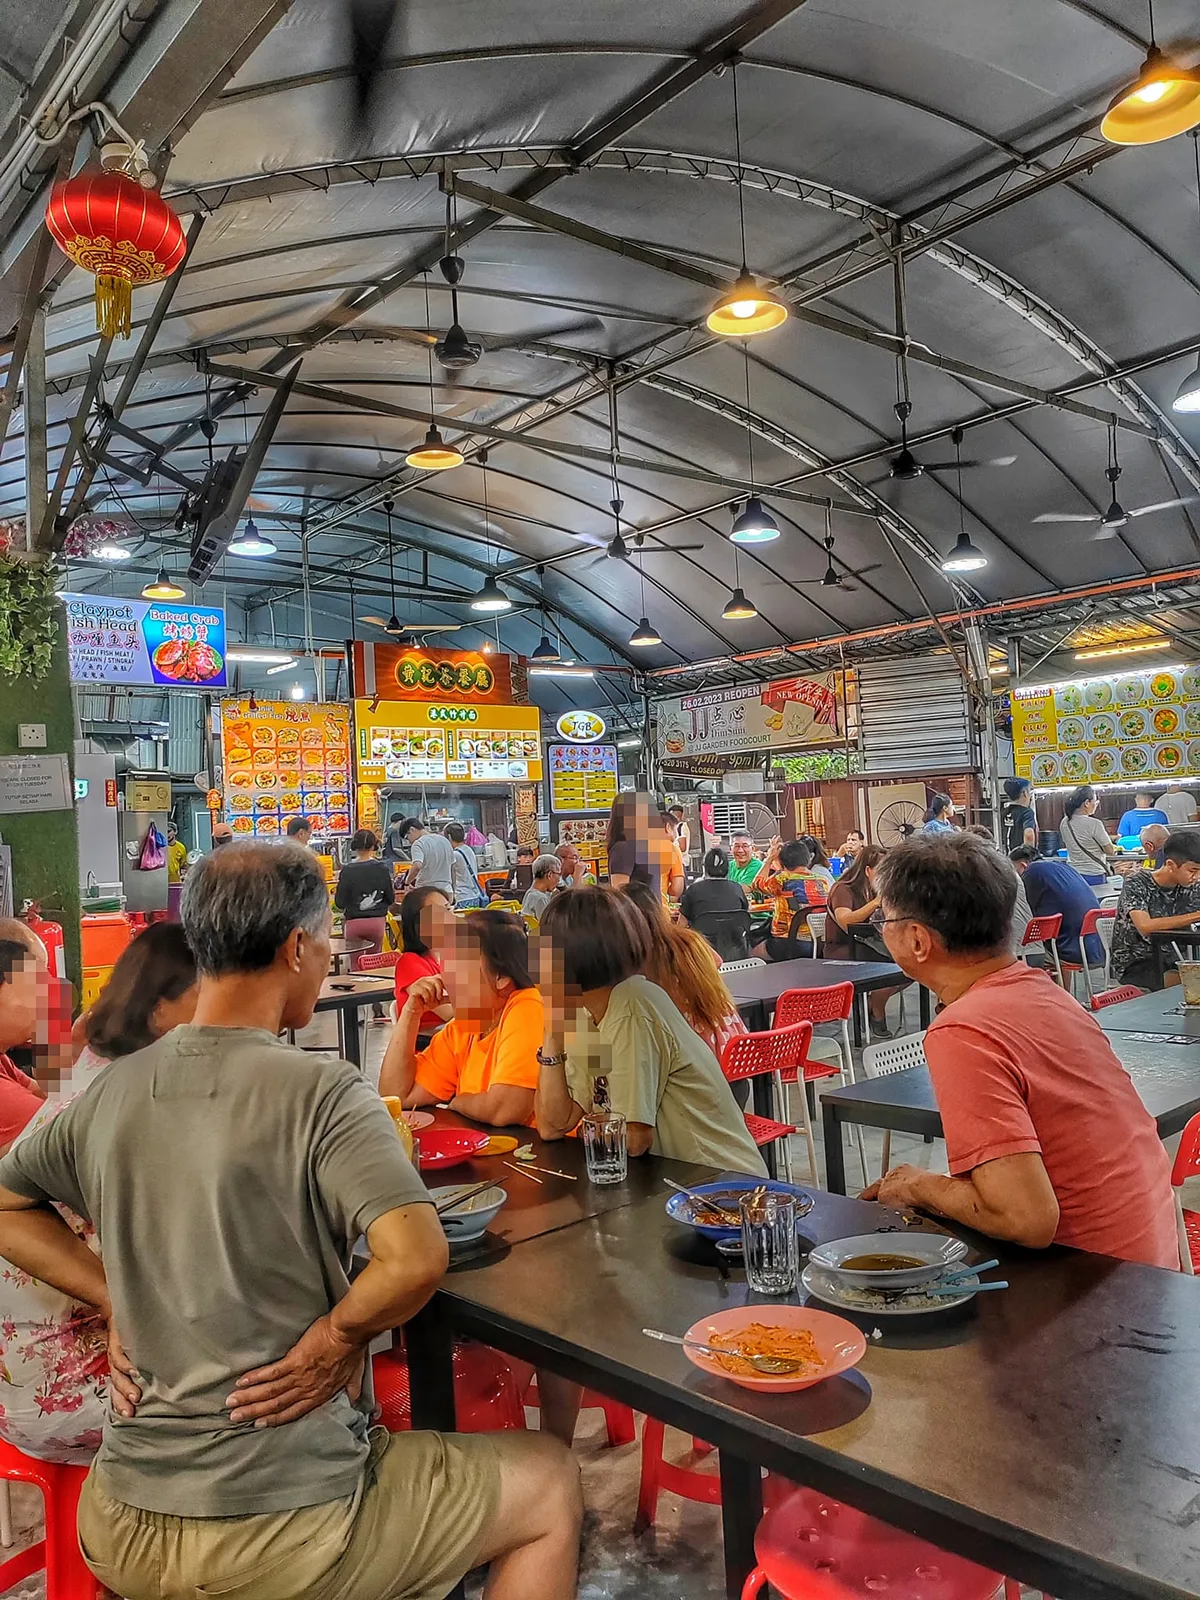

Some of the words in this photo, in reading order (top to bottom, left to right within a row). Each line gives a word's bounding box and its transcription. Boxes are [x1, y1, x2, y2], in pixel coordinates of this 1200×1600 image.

[69, 602, 132, 618] Claypot
[151, 611, 188, 622] Baked
[191, 614, 219, 625] Crab
[71, 616, 94, 629] ish
[99, 618, 137, 632] Head
[682, 694, 722, 710] 26.02.2023
[724, 685, 760, 701] REOPEN
[776, 691, 793, 699] NEW
[796, 693, 829, 712] OPENING
[572, 720, 592, 731] TGB
[688, 707, 711, 742] JJ
[711, 705, 745, 726] 点心
[702, 739, 728, 750] GARDEN
[729, 733, 772, 747] FOODCOURT
[728, 754, 752, 768] 9pm
[690, 766, 716, 775] CLOSED
